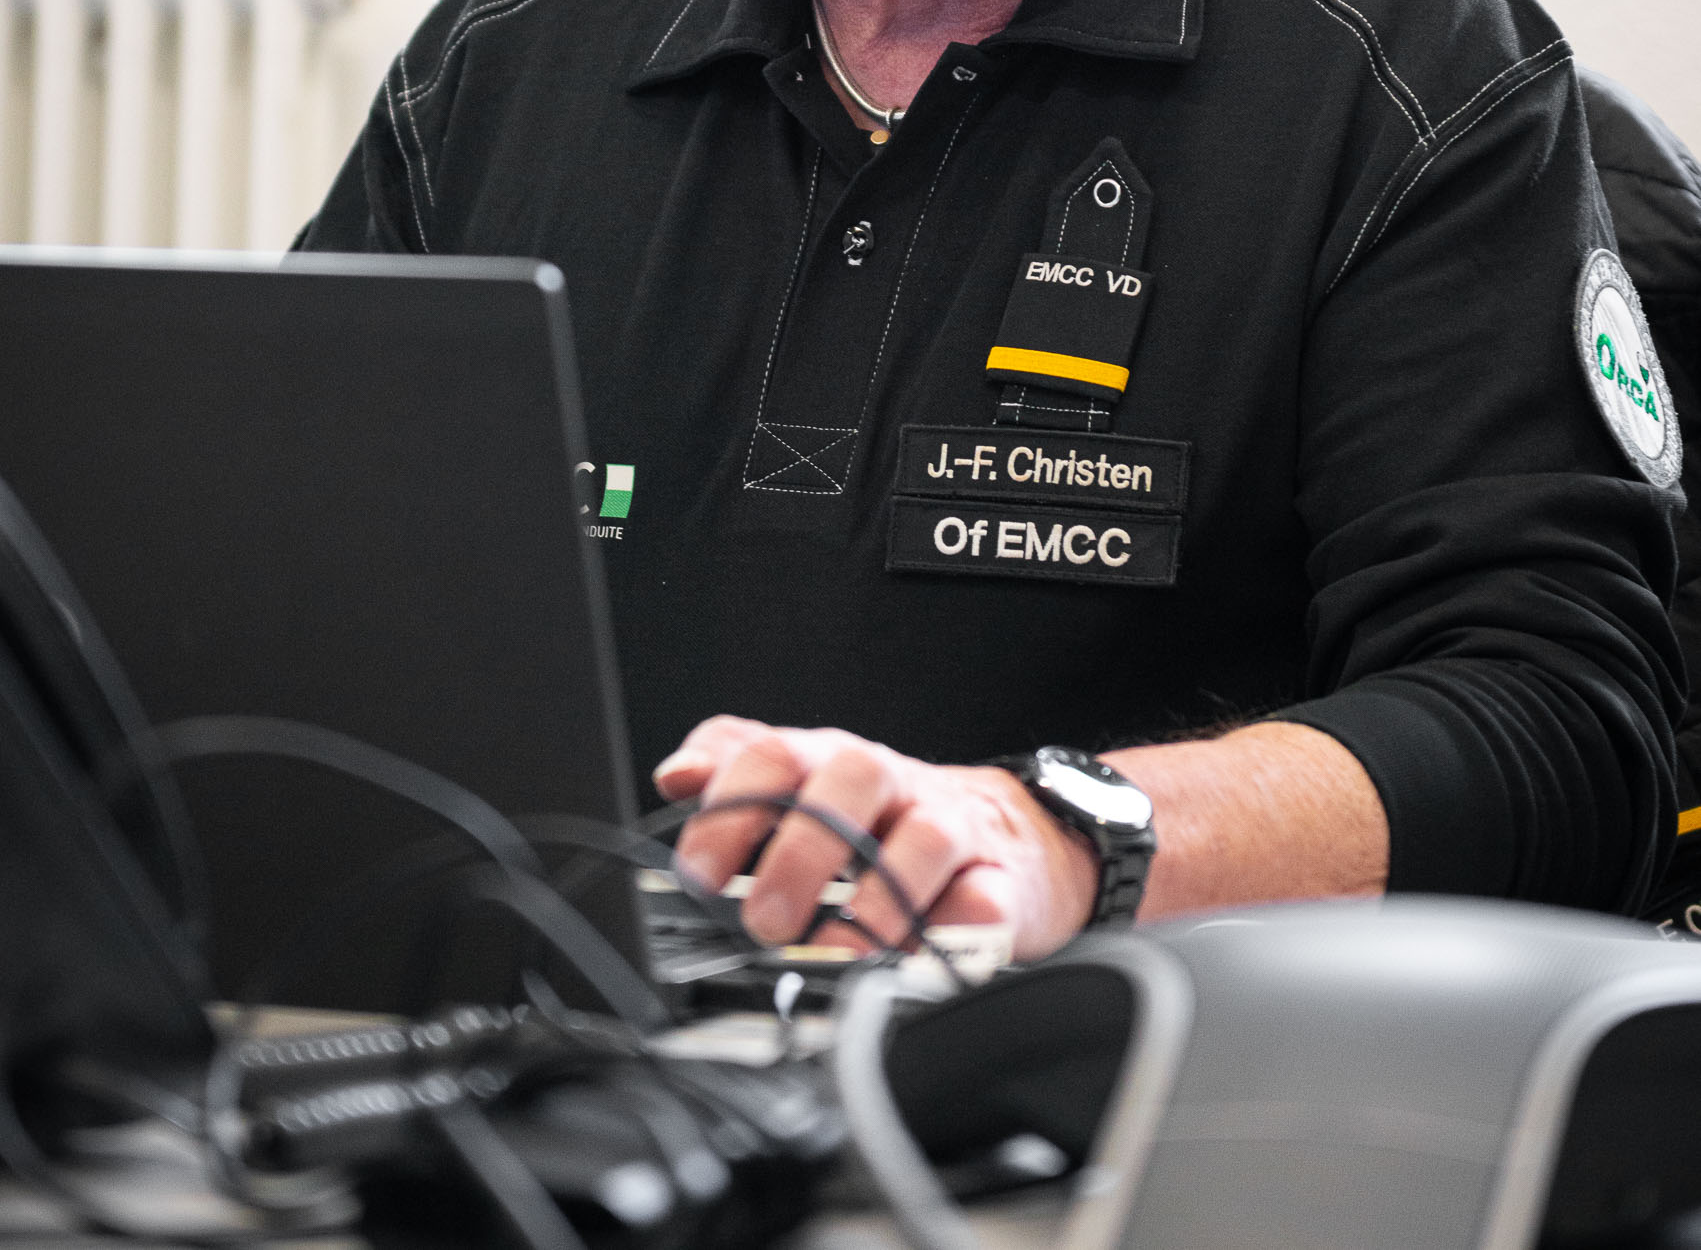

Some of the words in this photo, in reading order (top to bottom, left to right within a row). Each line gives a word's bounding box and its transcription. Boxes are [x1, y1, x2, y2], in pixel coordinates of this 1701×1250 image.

[1025, 261, 1095, 287] EMCC
[1106, 270, 1142, 297] VD
[927, 443, 998, 481] J.-F.
[1006, 446, 1153, 492] Christen
[933, 516, 989, 557] Of
[995, 520, 1132, 567] EMCC
